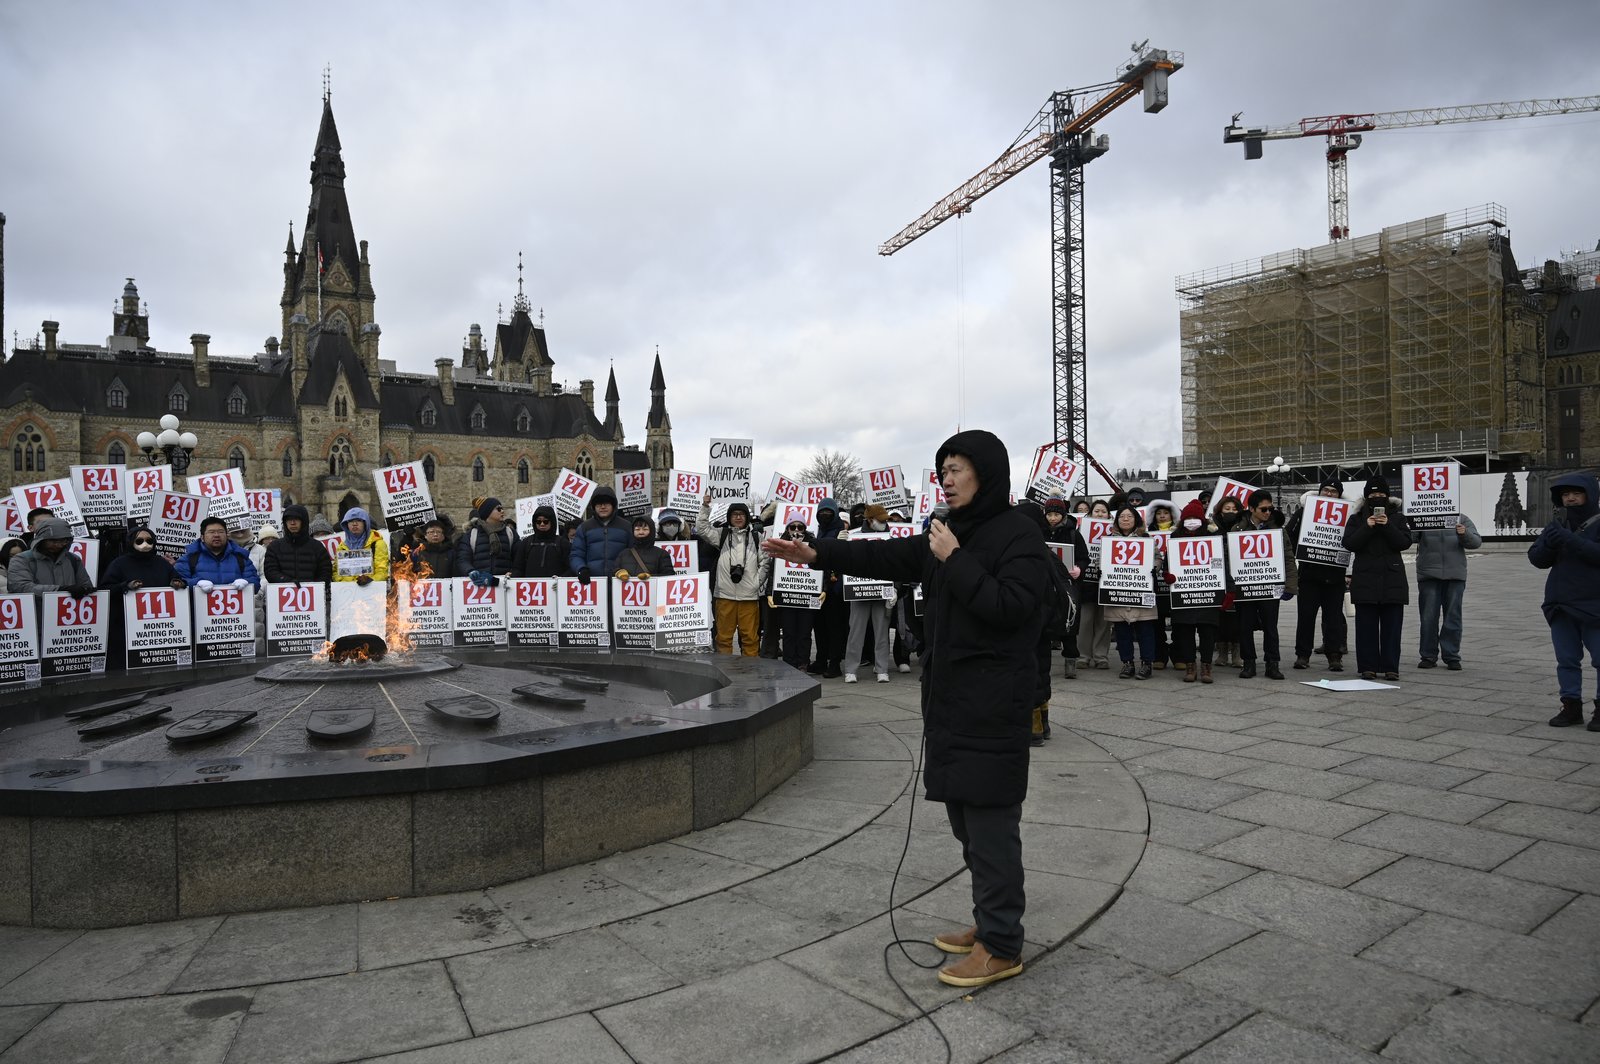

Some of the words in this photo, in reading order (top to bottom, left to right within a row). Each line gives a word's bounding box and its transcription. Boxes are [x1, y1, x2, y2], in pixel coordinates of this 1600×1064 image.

[710, 442, 752, 459] CANADA
[87, 469, 114, 490] 34
[390, 468, 413, 490] 42
[709, 465, 733, 481] WHAT
[733, 467, 749, 480] ARE
[873, 471, 893, 489] 40
[1051, 459, 1072, 480] 33
[1418, 468, 1445, 490] 35
[137, 471, 159, 493] 23
[203, 474, 230, 497] 30
[564, 476, 587, 497] 27
[625, 474, 642, 491] 23
[679, 474, 698, 492] 38
[708, 486, 721, 499] YOU
[724, 482, 749, 499] DOING?
[778, 479, 796, 502] 36
[28, 485, 61, 508] 72
[247, 493, 269, 511] 18
[393, 491, 416, 499] MONTHS
[166, 496, 197, 521] 30
[214, 506, 245, 516] RESPONSE
[400, 502, 428, 512] RESPONSE
[520, 501, 533, 516] 58
[1317, 501, 1342, 525] 15
[156, 528, 182, 536] WAITING
[164, 522, 191, 530] MONTHS
[1308, 532, 1332, 541] WAITING
[1315, 525, 1340, 534] MONTHS
[665, 545, 687, 566] 34
[1115, 542, 1140, 564] 32
[1183, 541, 1209, 564] 40
[1243, 534, 1269, 558] 20
[282, 588, 310, 611] 20
[413, 583, 438, 606] 34
[467, 582, 492, 604] 22
[520, 583, 544, 605] 34
[571, 582, 593, 605] 31
[624, 582, 646, 605] 20
[670, 580, 694, 603] 42
[62, 596, 93, 625] 36
[142, 593, 170, 618] 11
[211, 590, 240, 615] 35
[52, 637, 83, 645] WAITING
[61, 628, 91, 636] MONTHS
[149, 637, 186, 645] RESPONSE
[65, 644, 102, 652] RESPONSE
